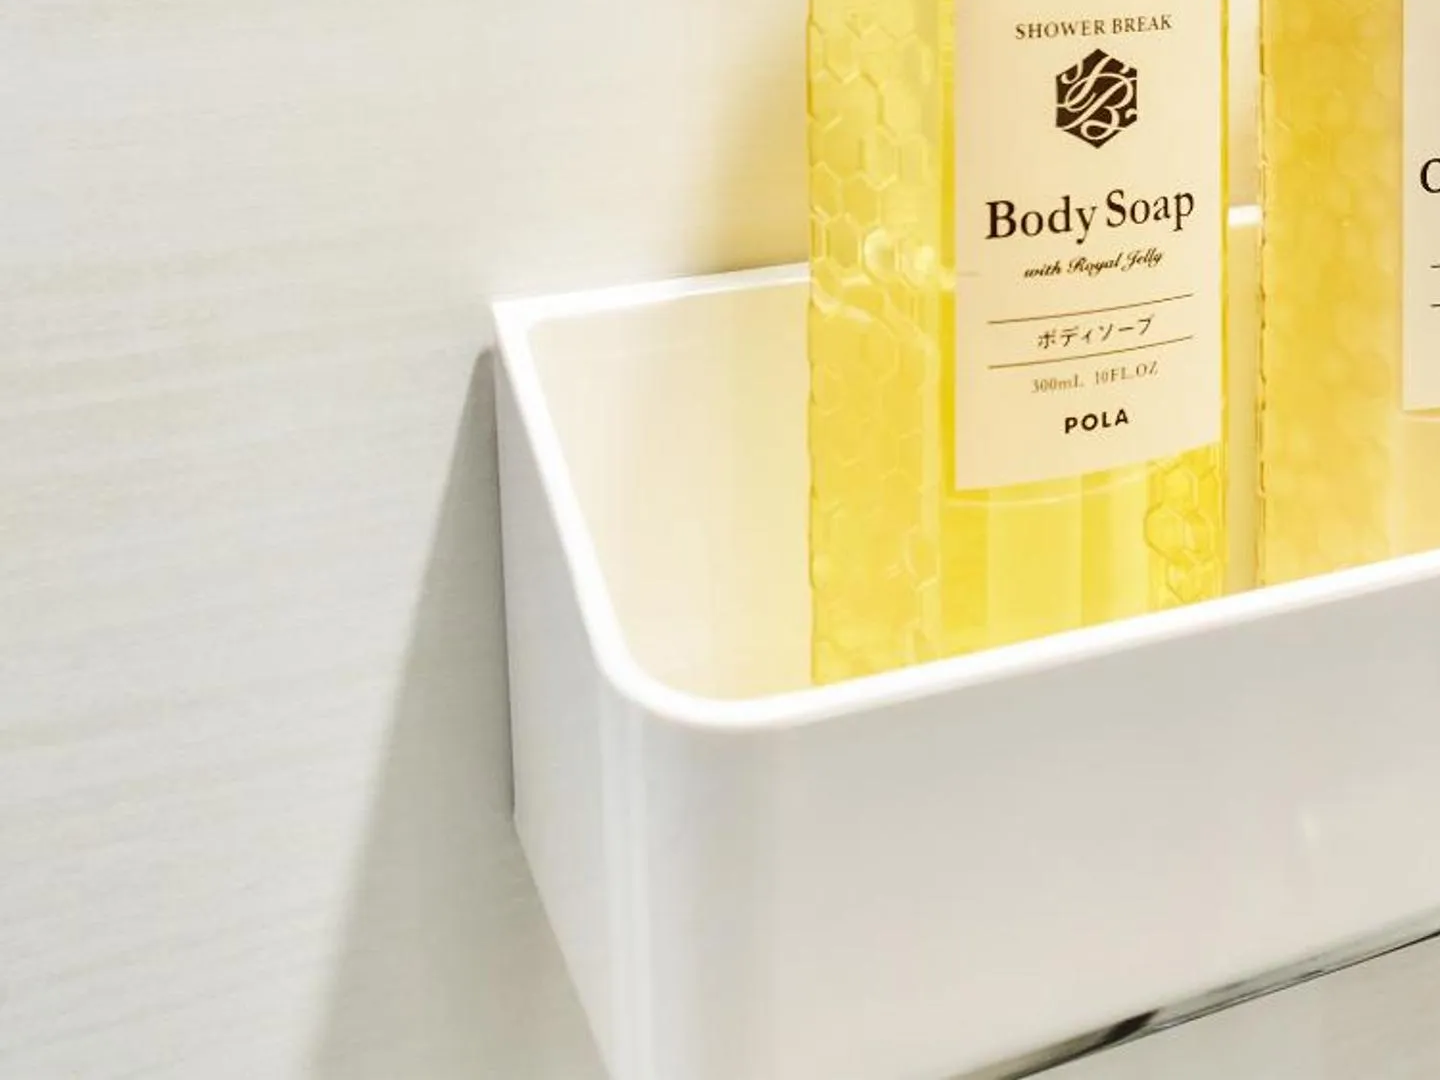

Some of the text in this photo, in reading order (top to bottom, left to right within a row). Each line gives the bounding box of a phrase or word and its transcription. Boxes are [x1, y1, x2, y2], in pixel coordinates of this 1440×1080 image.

[1015, 14, 1173, 39] SHOWER BREAK
[985, 188, 1195, 244] Body Soap
[1024, 247, 1164, 279] with Royal Jelly
[1030, 374, 1084, 394] 300mL
[1064, 408, 1130, 434] POLA
